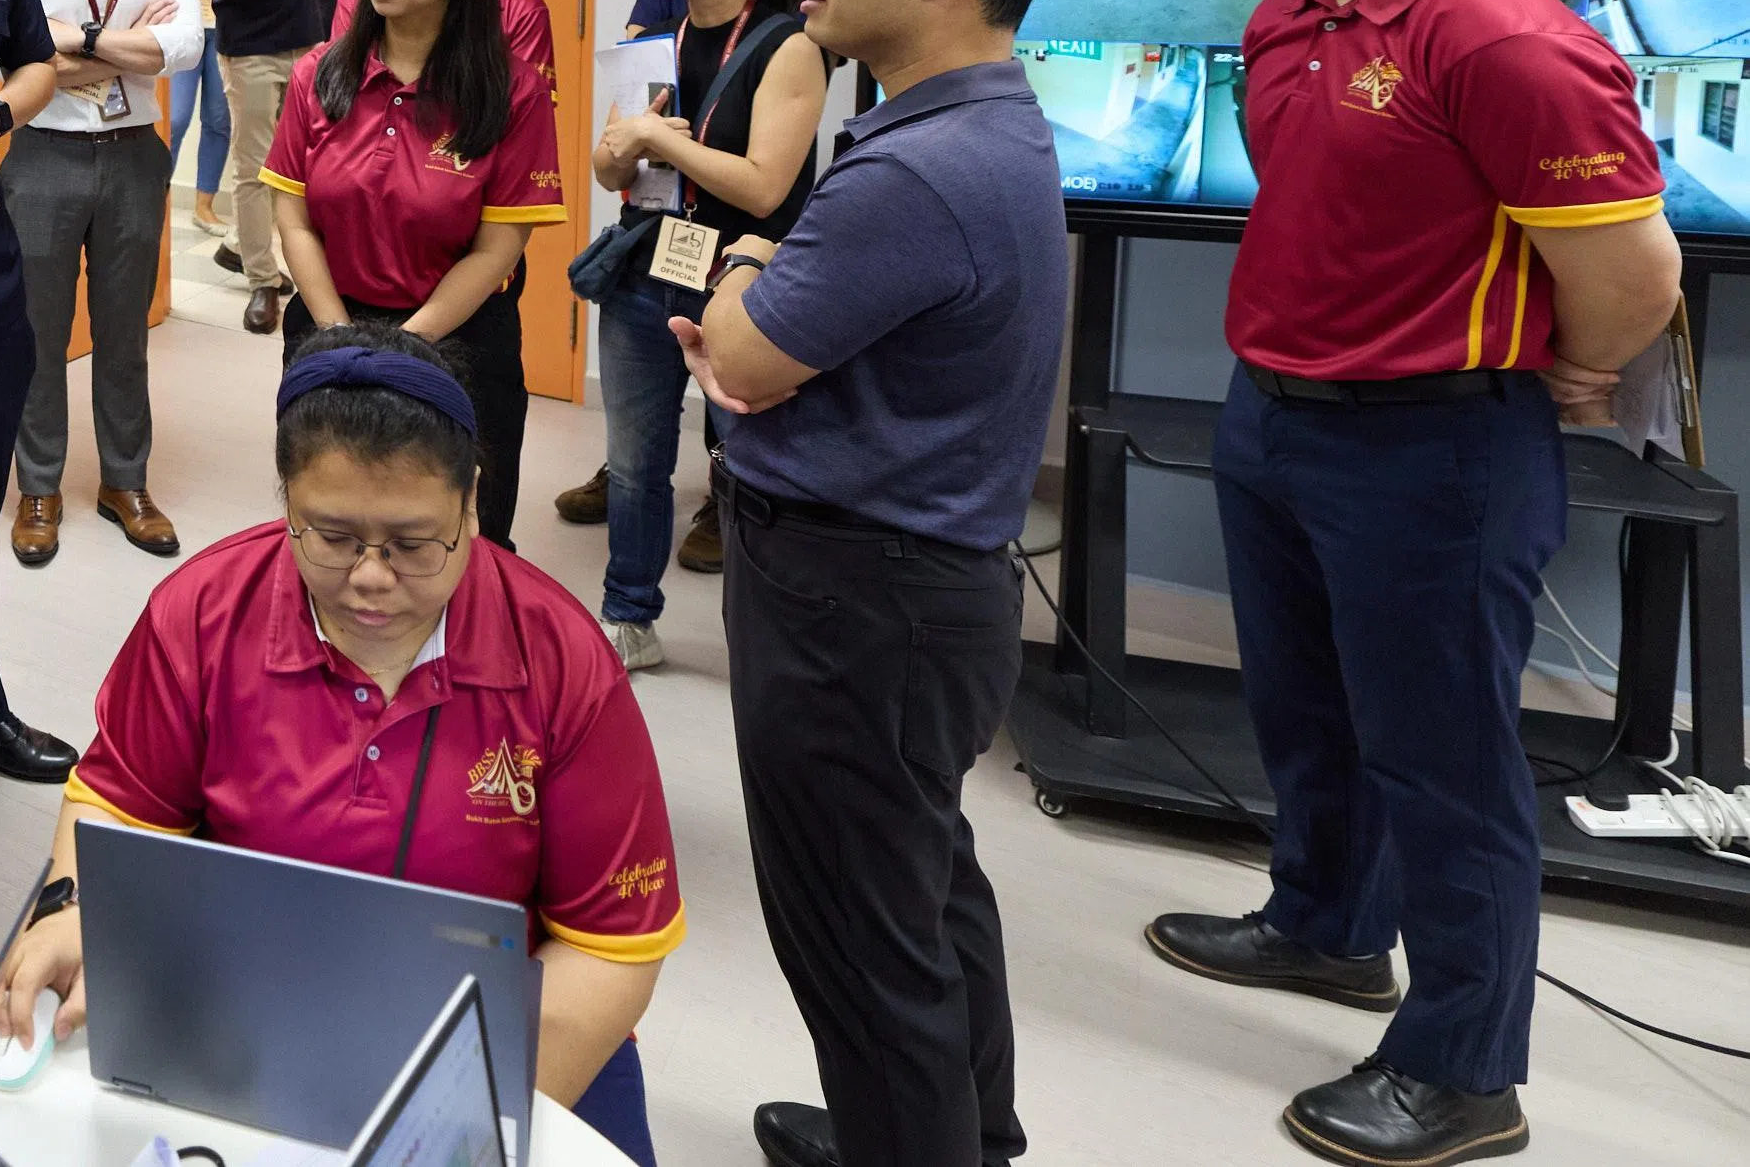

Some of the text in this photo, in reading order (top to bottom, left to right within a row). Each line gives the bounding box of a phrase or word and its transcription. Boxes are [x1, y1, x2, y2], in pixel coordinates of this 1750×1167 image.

[1538, 151, 1626, 170] Celebrating
[1554, 165, 1618, 180] 40 Years
[666, 257, 698, 272] MOE HQ
[660, 266, 697, 283] OFFICIAL
[467, 747, 496, 784] BBSS
[618, 883, 635, 899] 40
